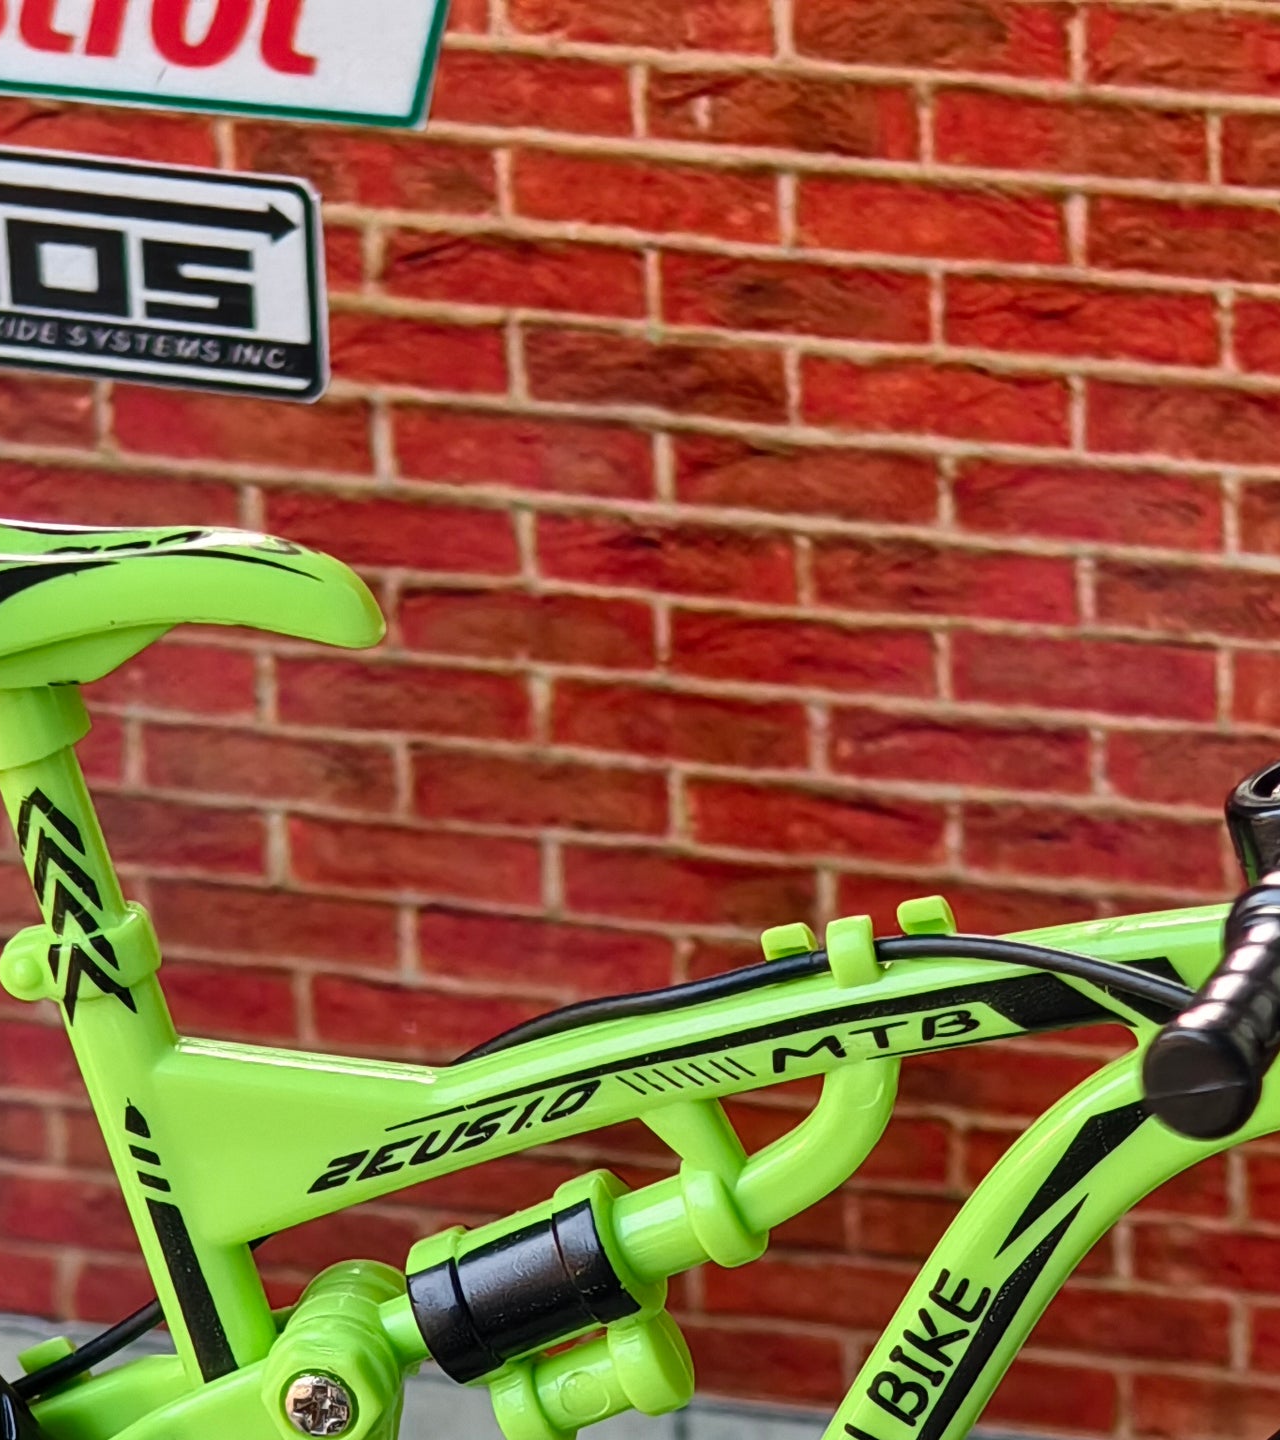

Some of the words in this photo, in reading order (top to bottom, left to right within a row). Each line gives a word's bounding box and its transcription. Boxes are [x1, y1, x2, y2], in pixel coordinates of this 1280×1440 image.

[66, 325, 220, 363] SYSTEMS
[772, 1009, 980, 1074] MTB
[867, 1268, 991, 1427] BIKE
